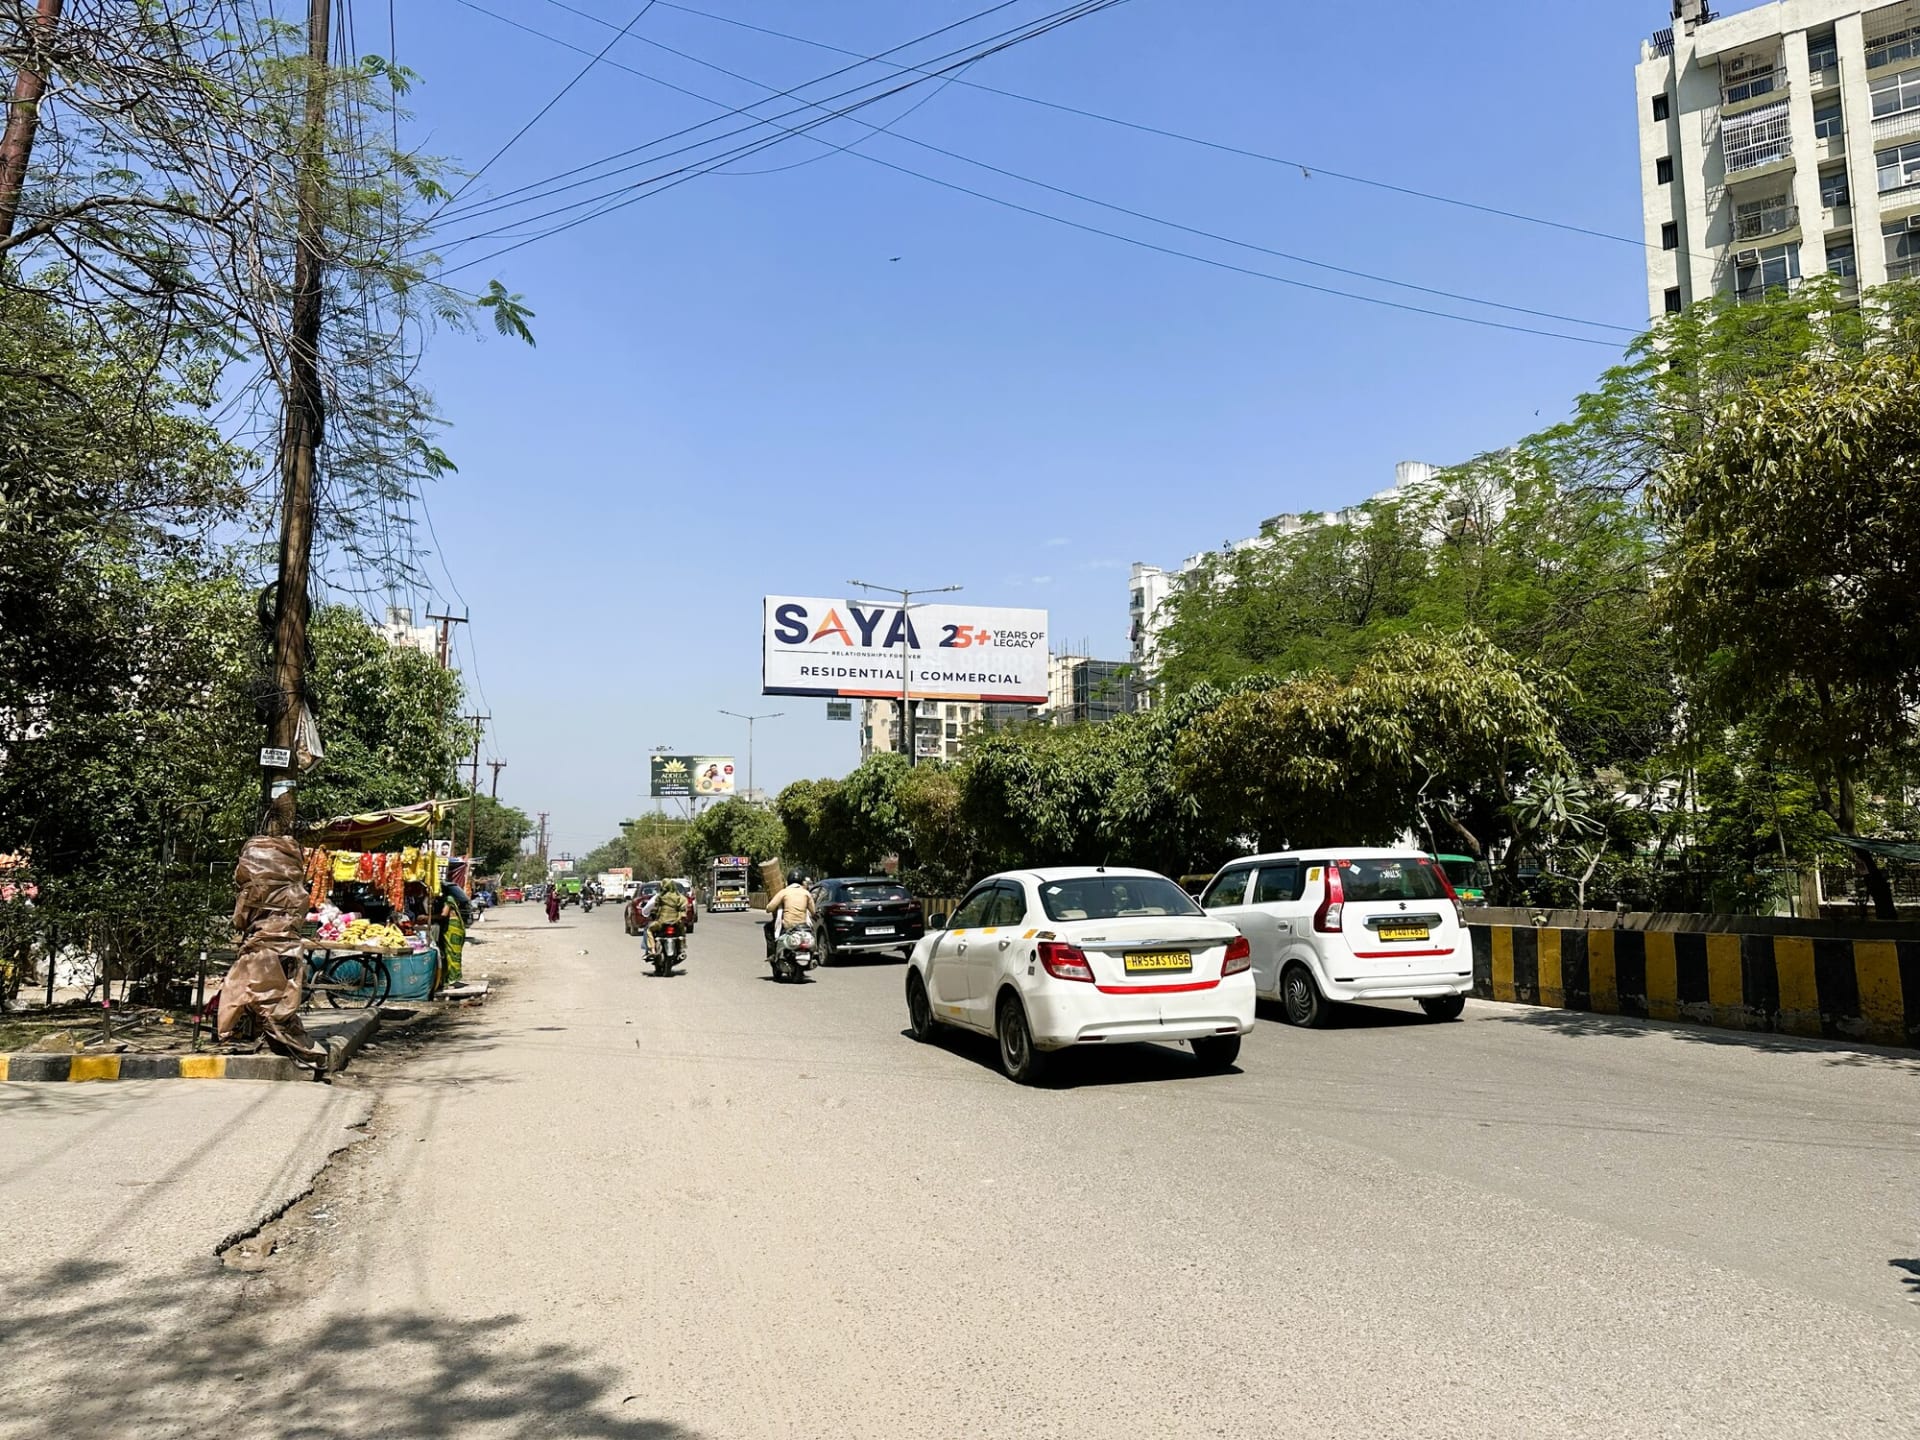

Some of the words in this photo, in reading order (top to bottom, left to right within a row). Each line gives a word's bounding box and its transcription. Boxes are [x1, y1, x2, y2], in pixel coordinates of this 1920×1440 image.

[774, 603, 921, 649] SAYA
[939, 624, 992, 649] 25+
[993, 629, 1028, 640] YEARS
[1030, 631, 1045, 640] OF
[993, 639, 1035, 648] LEGACY
[831, 650, 887, 659] RELATIONSHIPS
[889, 652, 921, 660] FORVER
[800, 666, 904, 680] RESIDENTIAL
[920, 670, 1022, 684] COMMERCIAL
[1131, 954, 1190, 967] HR55AS1056
